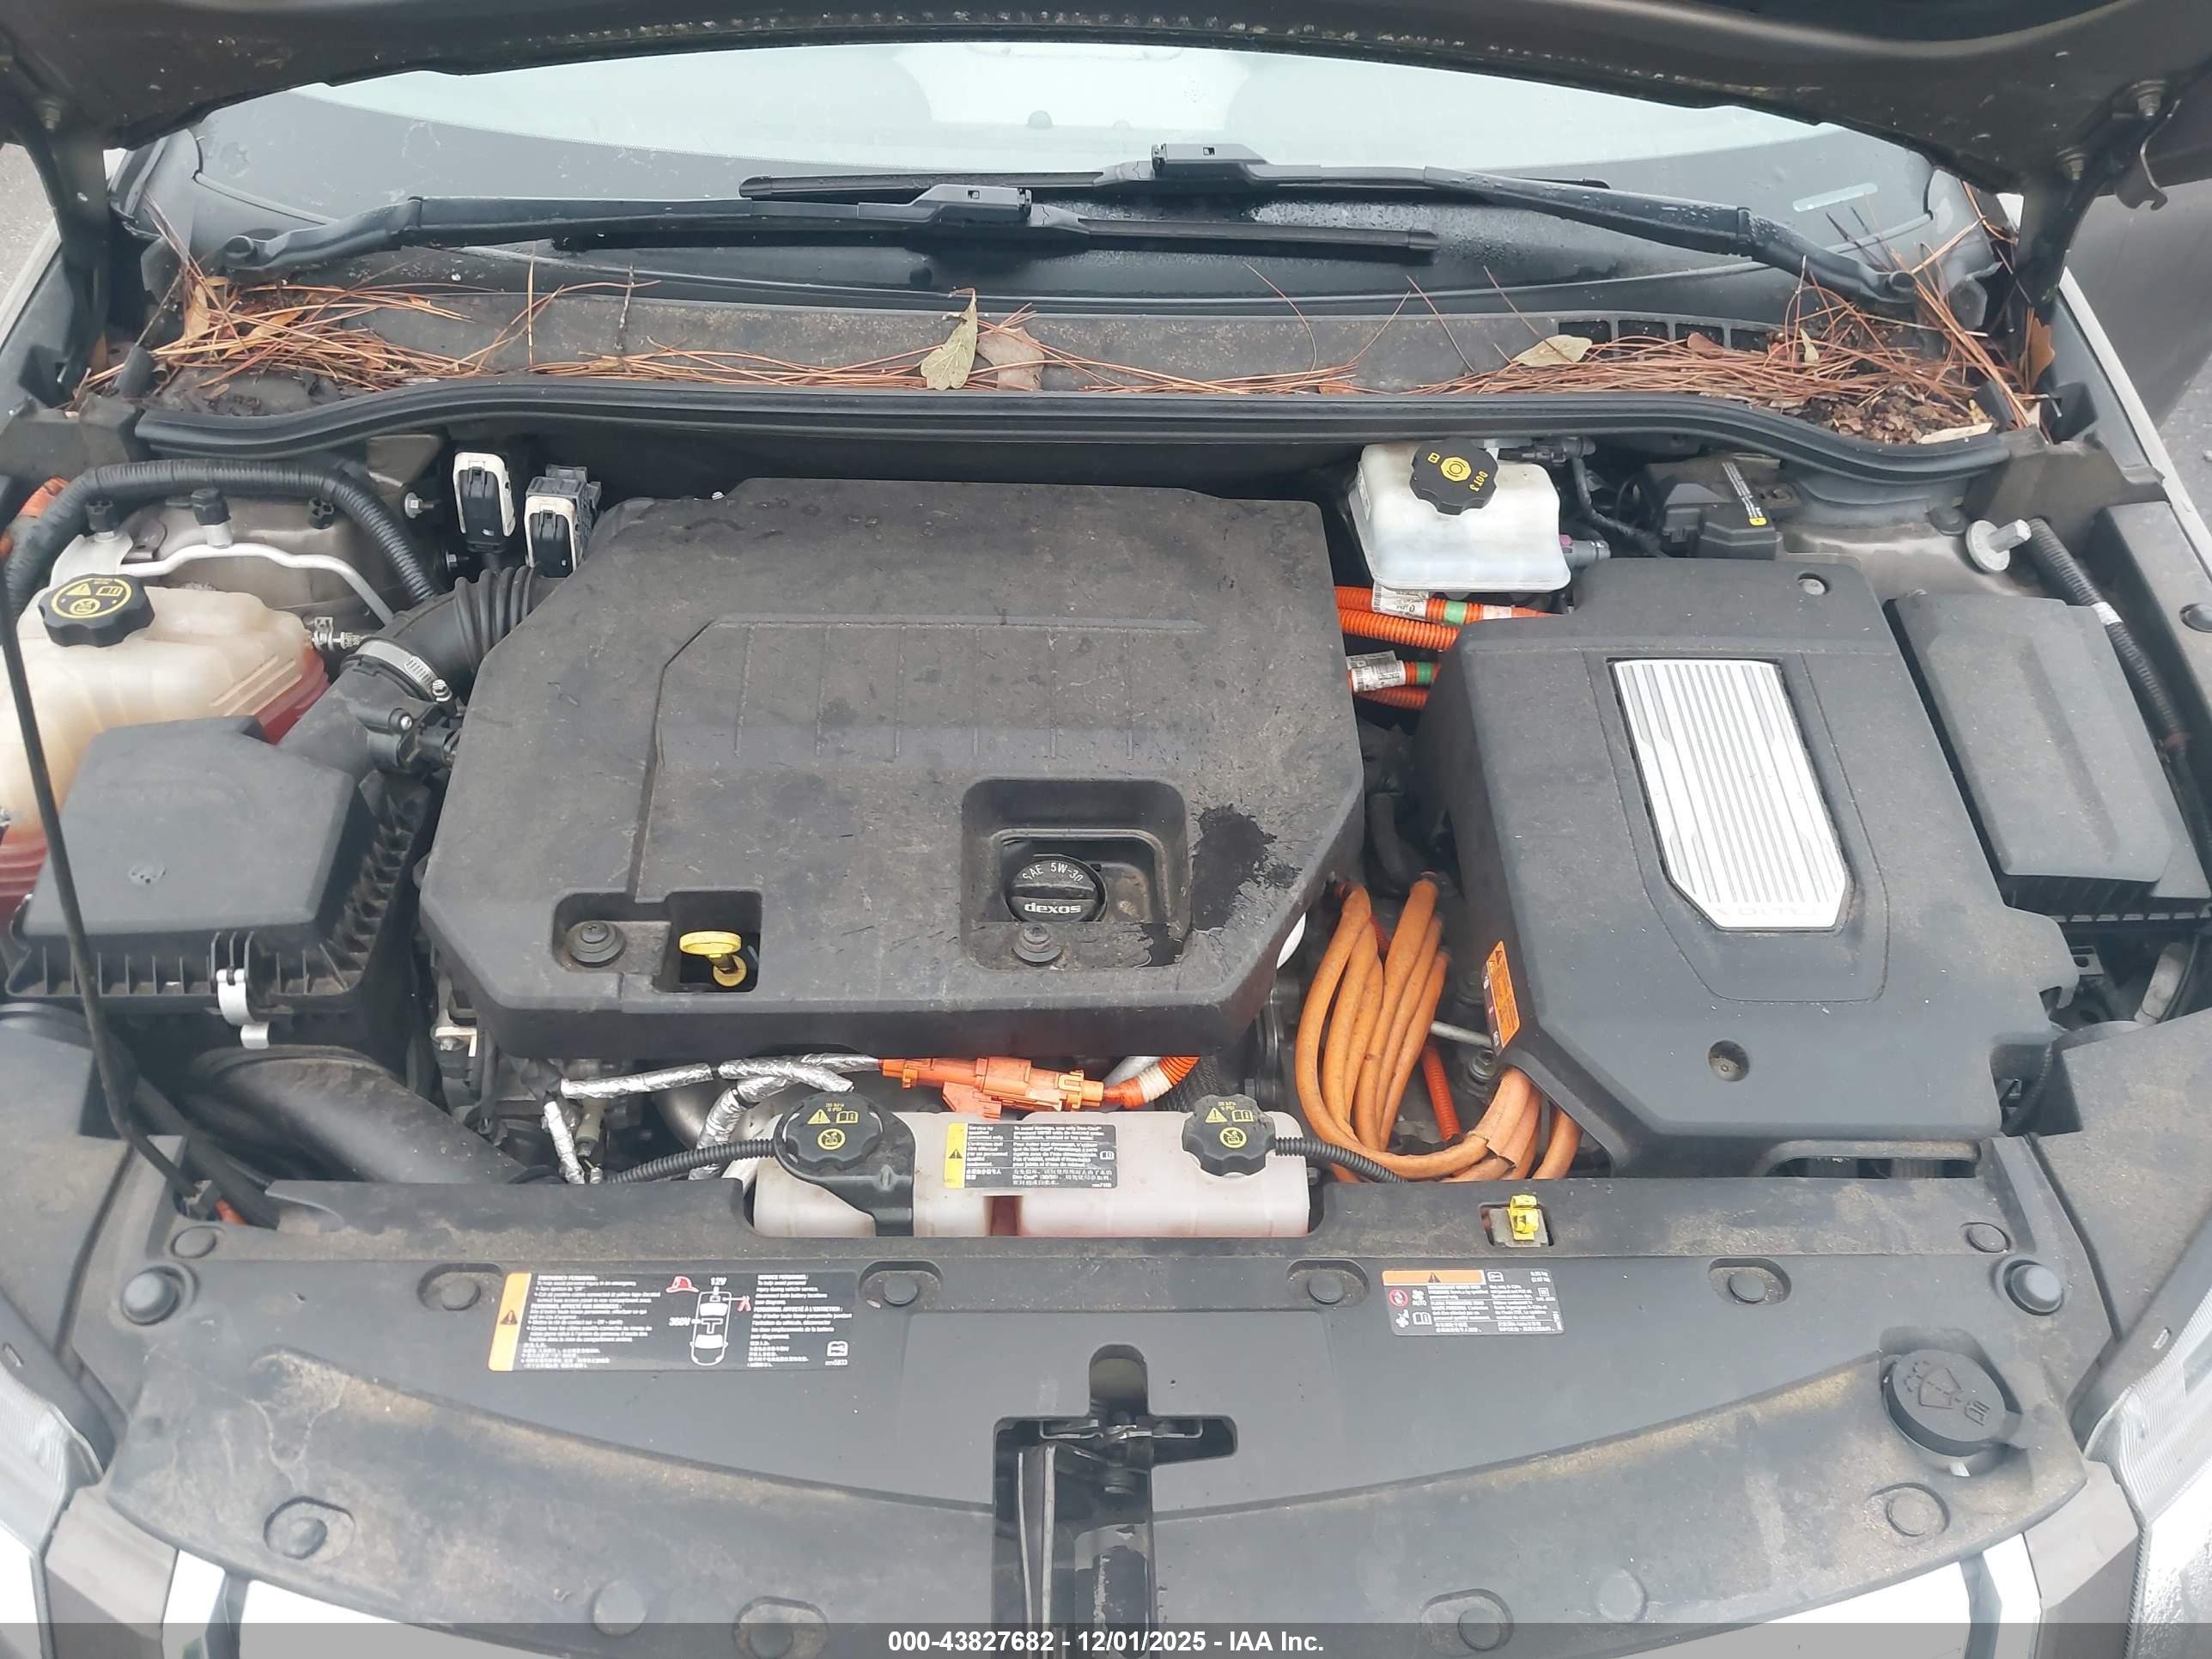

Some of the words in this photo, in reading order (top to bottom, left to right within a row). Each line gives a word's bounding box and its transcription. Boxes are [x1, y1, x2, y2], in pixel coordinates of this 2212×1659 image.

[1022, 864, 1044, 880] SAE
[1050, 862, 1084, 882] 5W-30
[1024, 902, 1082, 914] dexos
[710, 1277, 727, 1285] 12V
